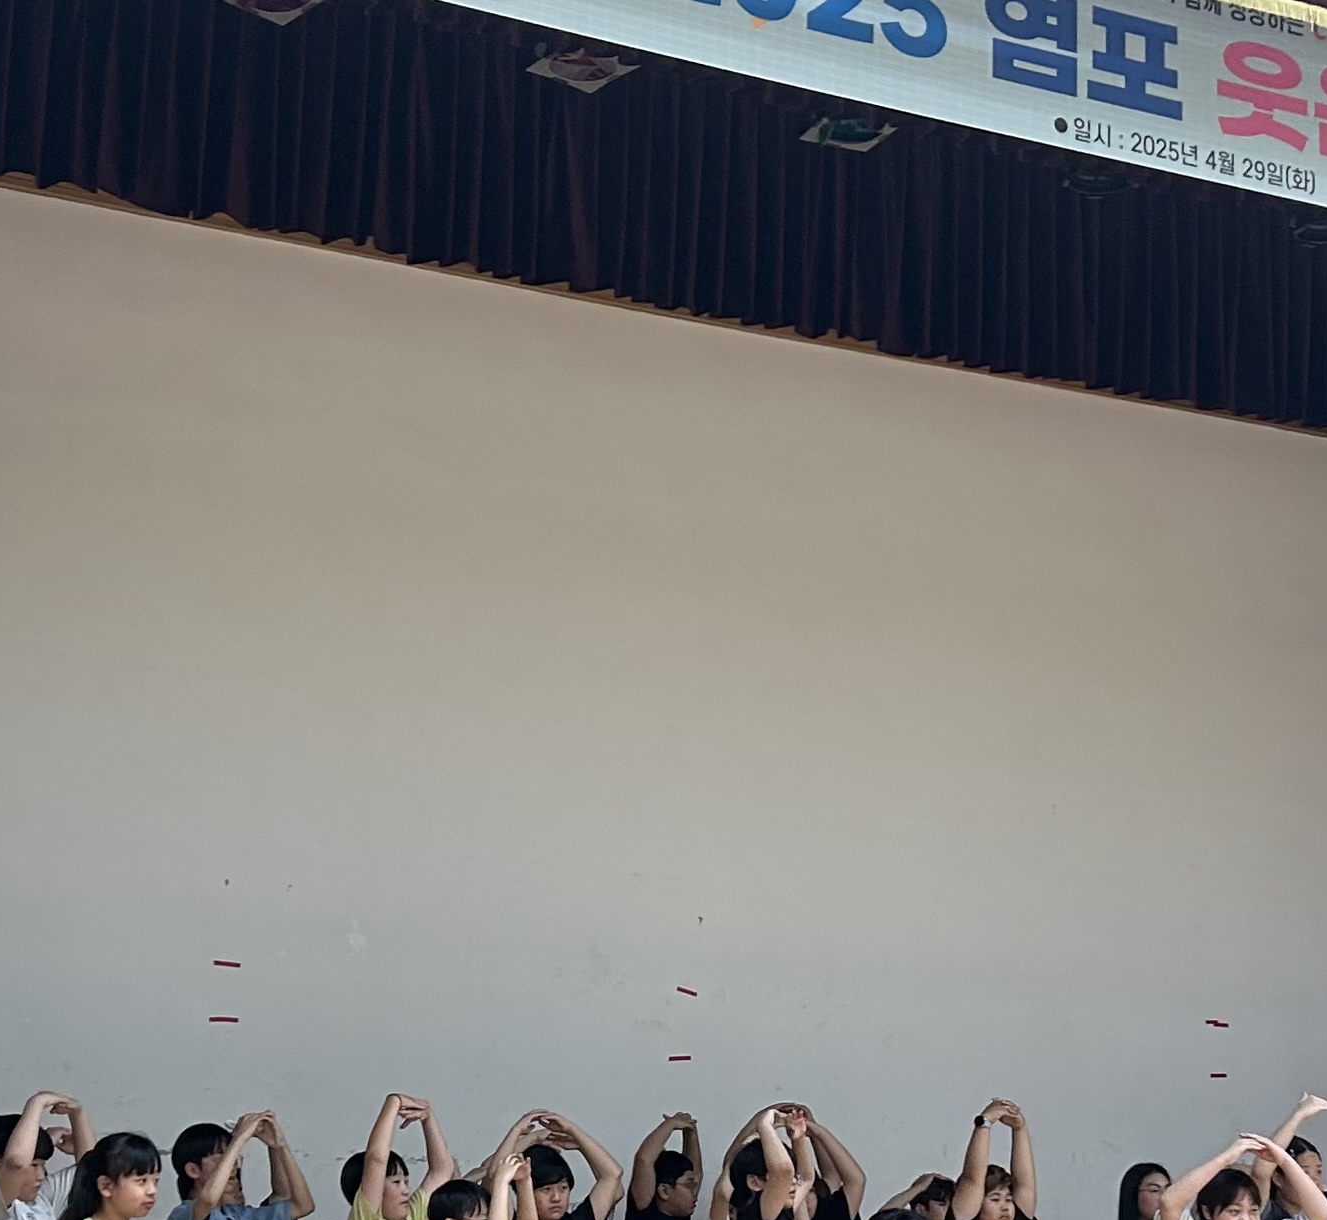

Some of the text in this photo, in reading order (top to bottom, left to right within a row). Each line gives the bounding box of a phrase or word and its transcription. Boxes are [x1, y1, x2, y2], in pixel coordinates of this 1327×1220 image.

[984, 0, 1183, 121] 염포
[1074, 117, 1111, 148] 일시
[1130, 132, 1198, 168] 2025년
[1205, 150, 1235, 176] 4월
[1242, 158, 1316, 195] 29일(화)
